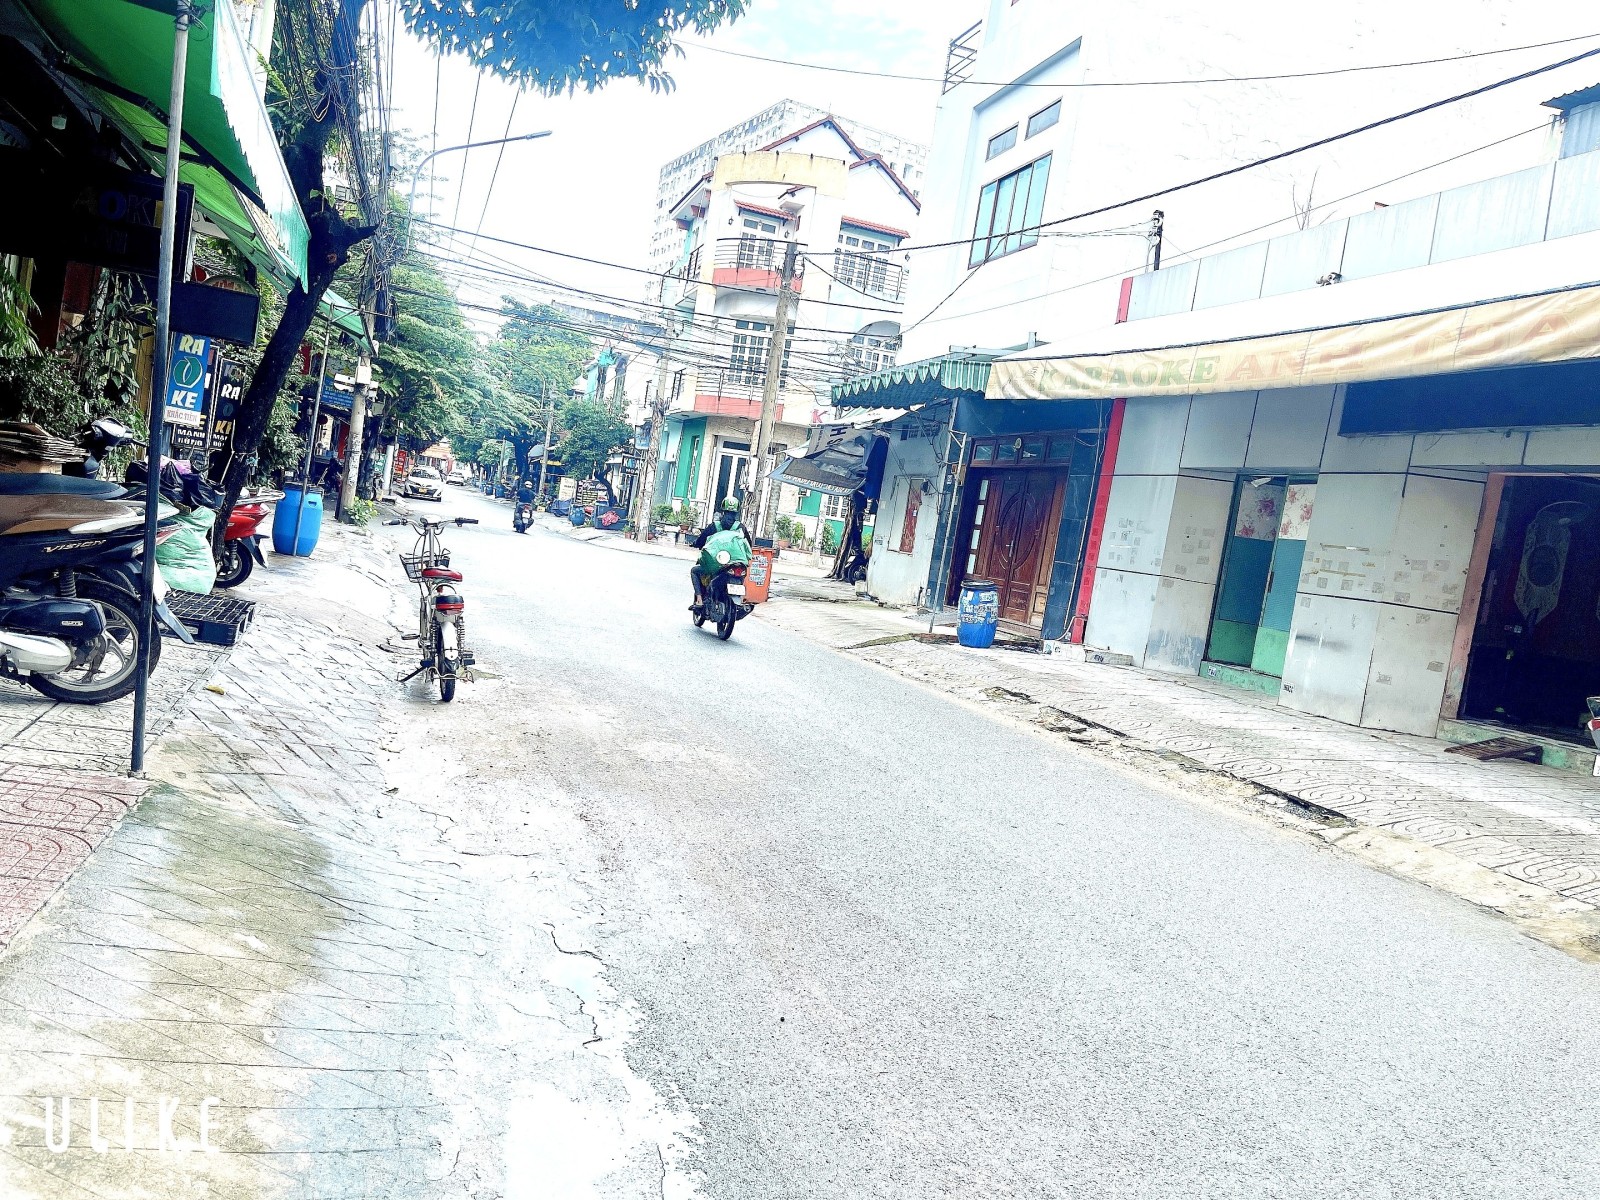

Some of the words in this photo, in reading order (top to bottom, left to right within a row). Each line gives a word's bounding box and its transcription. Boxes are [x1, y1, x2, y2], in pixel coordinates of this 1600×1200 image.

[179, 335, 205, 356] RA
[1038, 355, 1219, 392] KARAOKE
[171, 390, 198, 408] KE
[221, 383, 241, 401] RA
[43, 539, 107, 553] VISION
